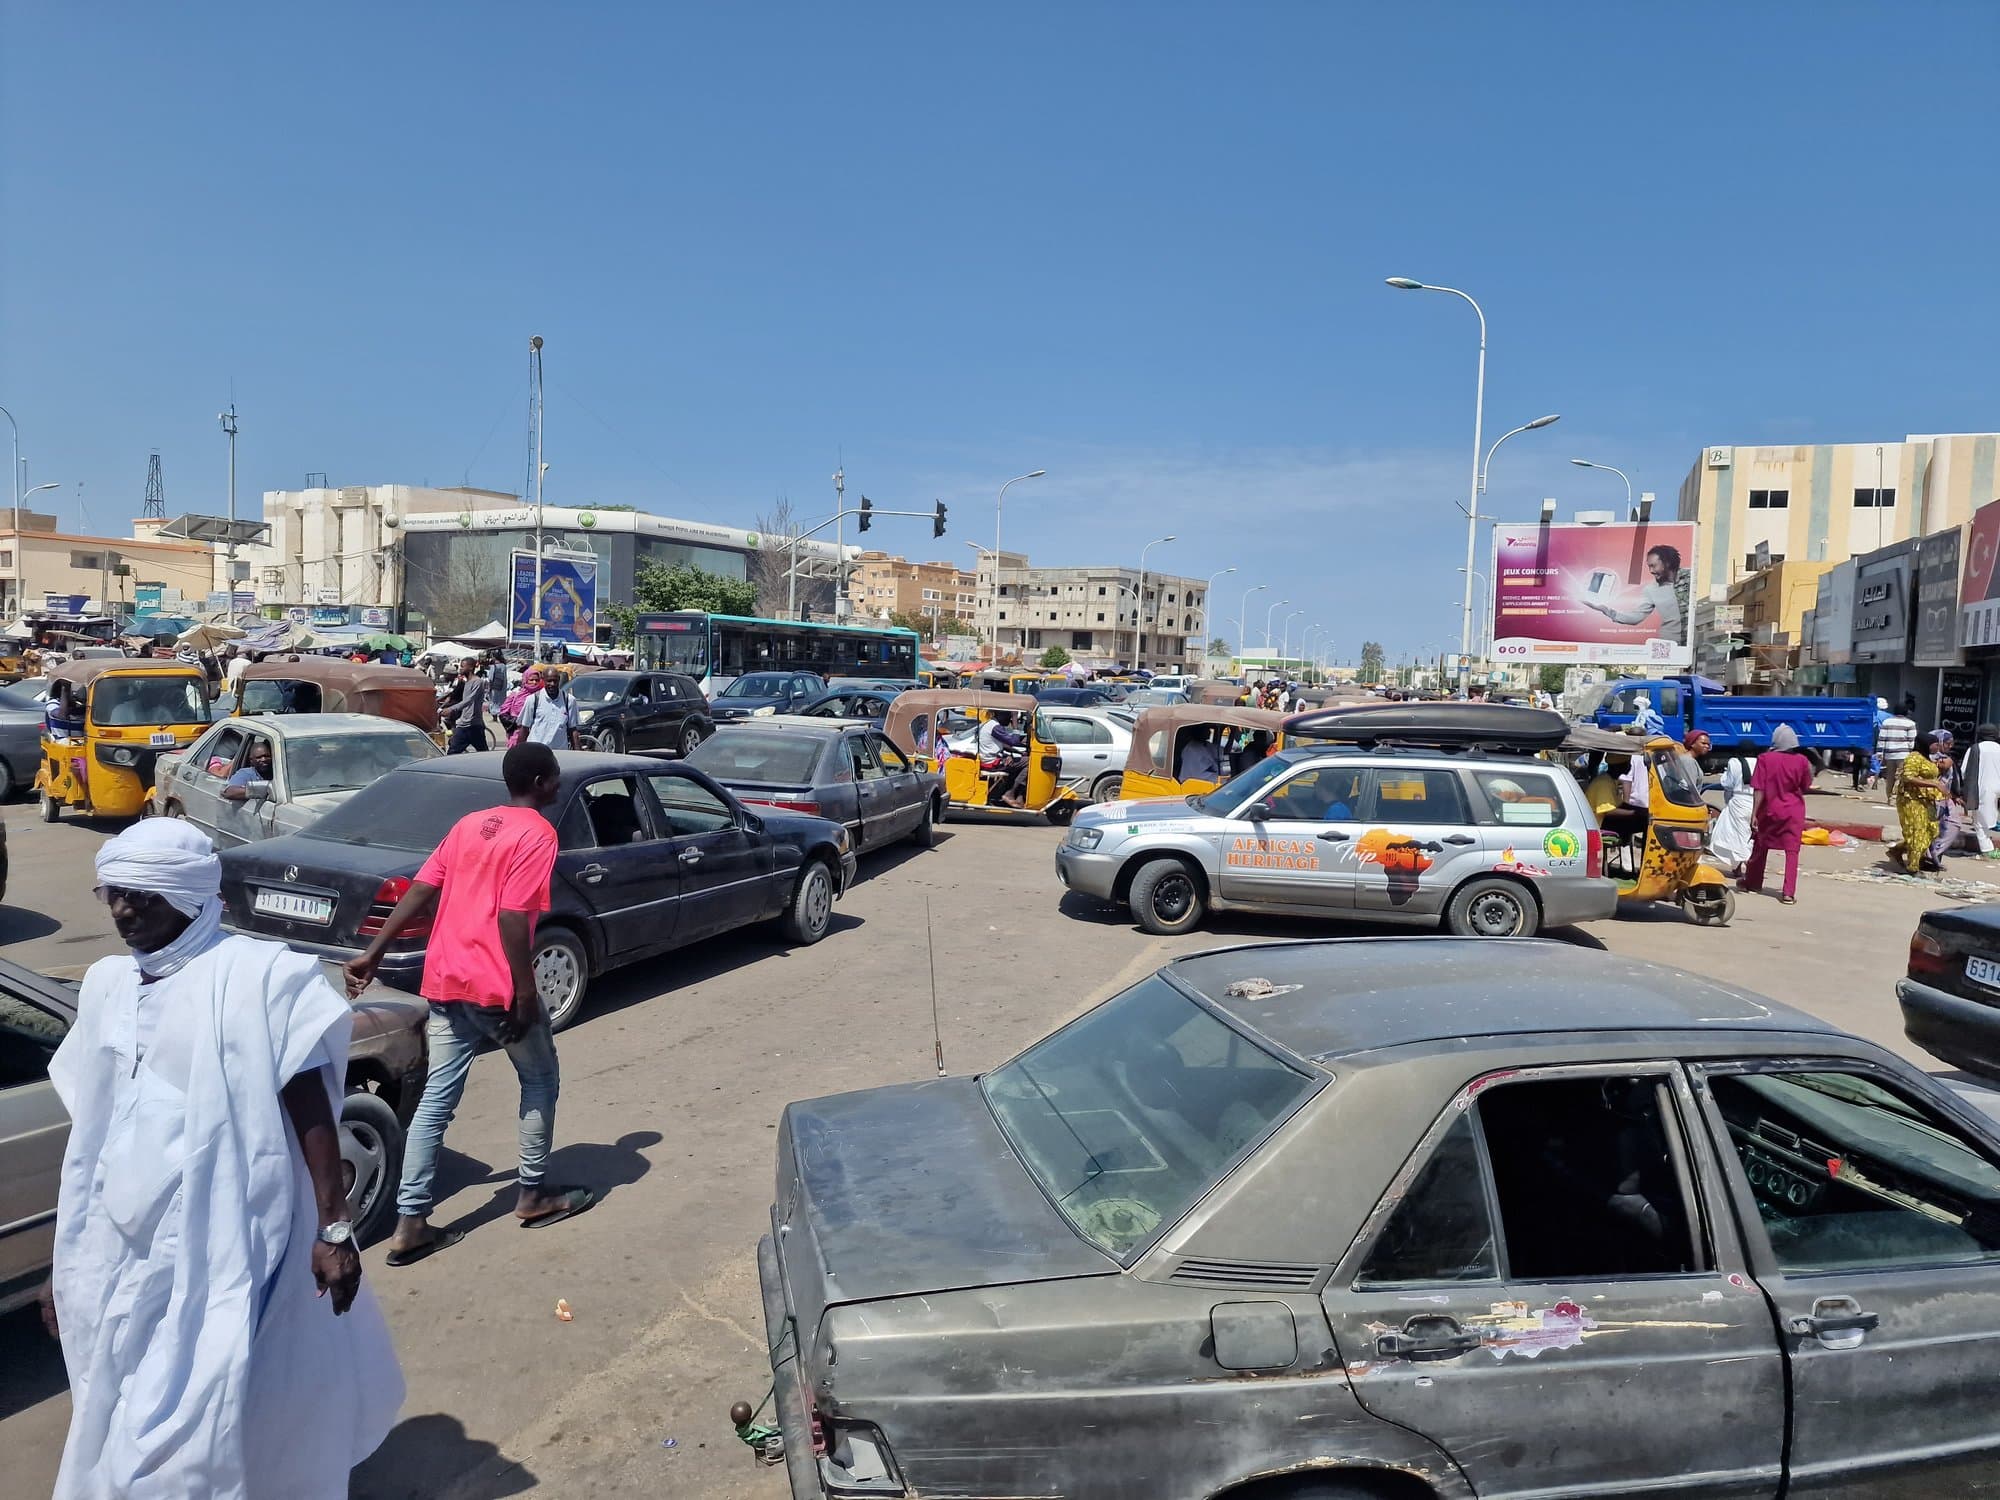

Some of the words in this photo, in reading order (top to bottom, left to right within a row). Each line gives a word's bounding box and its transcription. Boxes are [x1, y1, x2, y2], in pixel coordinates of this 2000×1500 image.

[1503, 568, 1520, 576] JEUX
[1521, 568, 1559, 576] CONCOURS
[1742, 722, 1752, 732] W
[1816, 723, 1826, 733] W
[1232, 836, 1316, 854] AFRICA'S
[1227, 853, 1320, 871] HERITAGE
[1335, 840, 1377, 870] Trip
[1548, 859, 1577, 867] CAF
